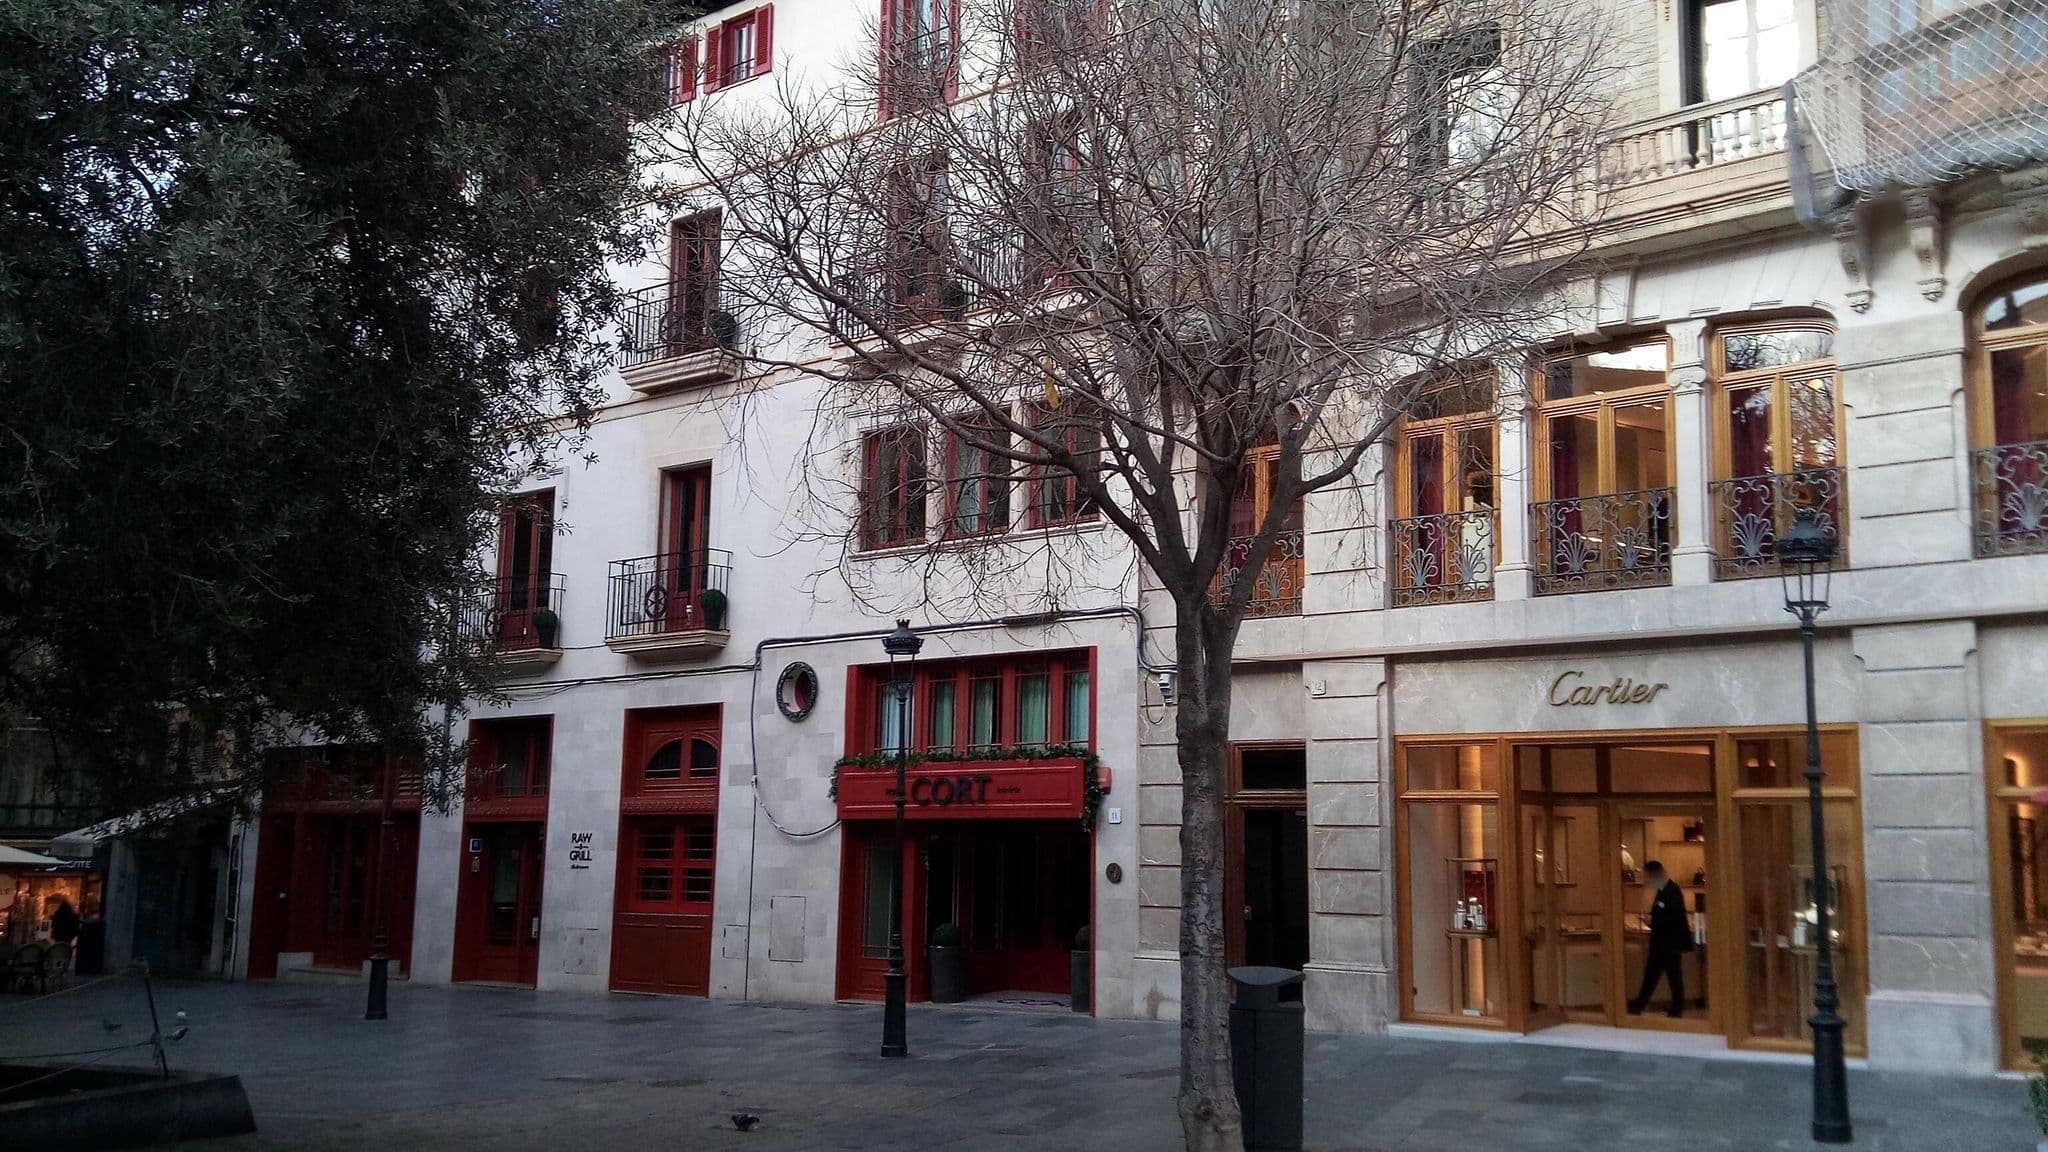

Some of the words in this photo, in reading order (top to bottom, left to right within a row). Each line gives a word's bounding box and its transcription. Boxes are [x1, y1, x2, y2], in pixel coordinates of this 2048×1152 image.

[1546, 670, 1669, 706] Cartier
[911, 774, 992, 806] CORT
[571, 832, 593, 844] RAW
[569, 850, 593, 861] GRILL
